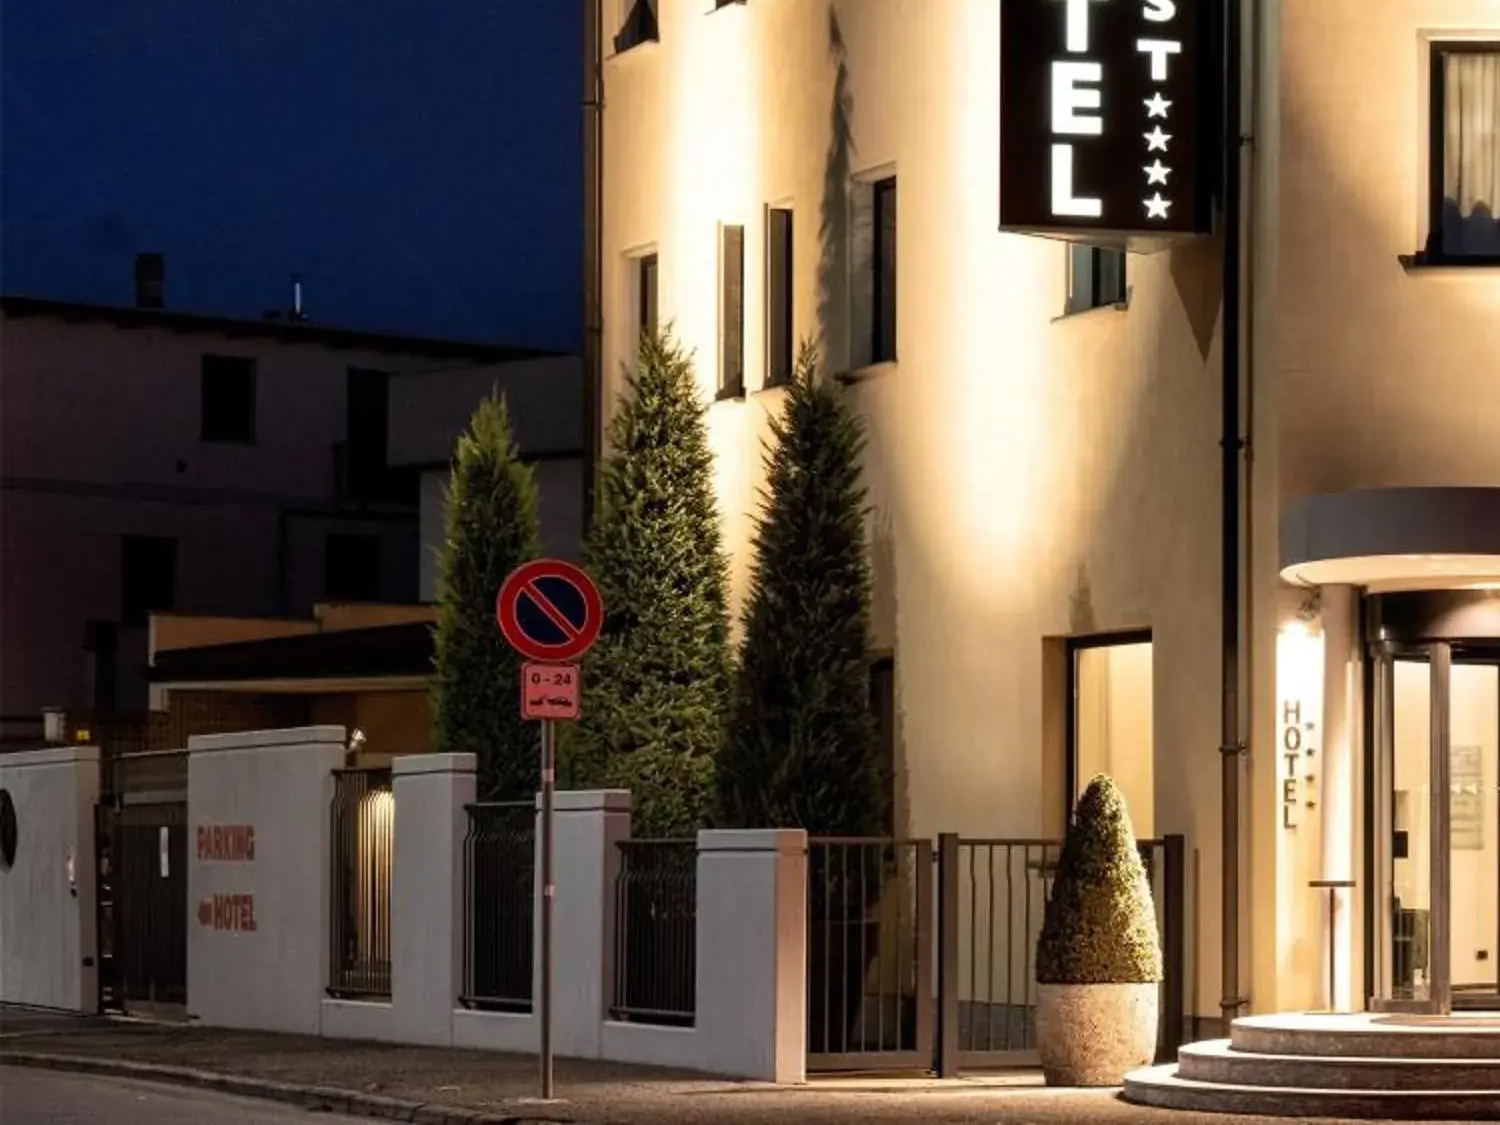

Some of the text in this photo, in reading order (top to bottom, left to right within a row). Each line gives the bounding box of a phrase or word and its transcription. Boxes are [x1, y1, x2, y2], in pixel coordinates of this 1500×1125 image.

[1283, 699, 1302, 830] HOTEL
[197, 824, 255, 861] PARKING
[213, 893, 257, 931] HOTEL
